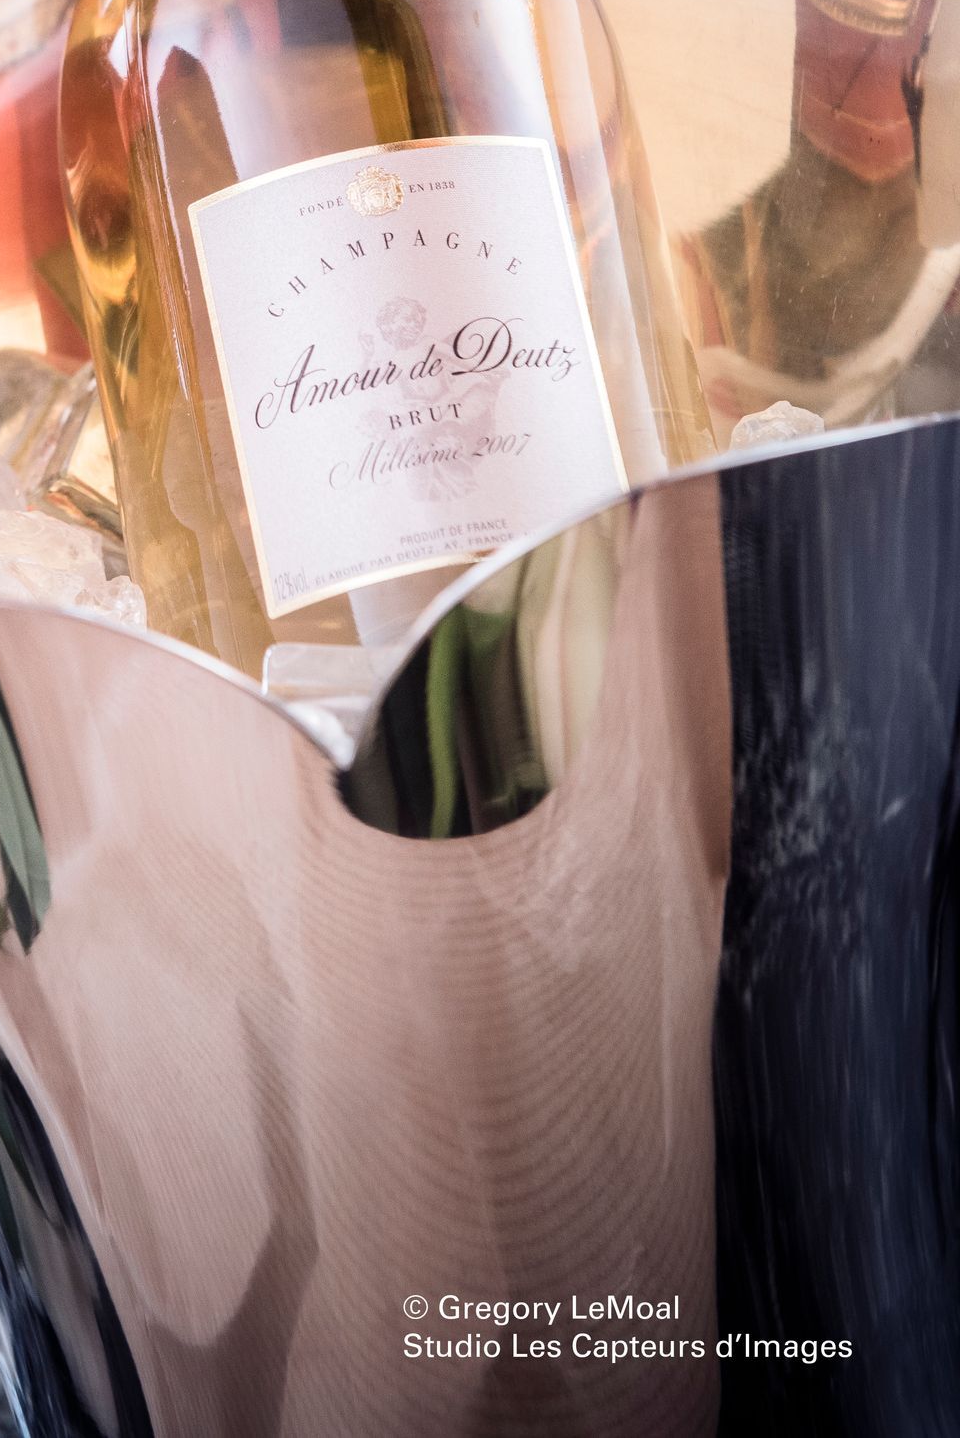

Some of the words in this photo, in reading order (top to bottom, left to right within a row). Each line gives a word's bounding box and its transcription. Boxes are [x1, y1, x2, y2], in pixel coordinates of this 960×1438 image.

[408, 182, 425, 194] EN
[429, 180, 455, 191] 1838
[268, 229, 522, 319] CHAMPAGNE
[255, 344, 403, 429] Amour
[409, 343, 443, 380] de
[451, 317, 580, 382] Deutz
[390, 403, 462, 430] BRUT
[471, 433, 532, 457] 2007
[399, 528, 446, 546] PRODUIT
[450, 525, 463, 537] DE
[467, 518, 508, 533] FRANCE
